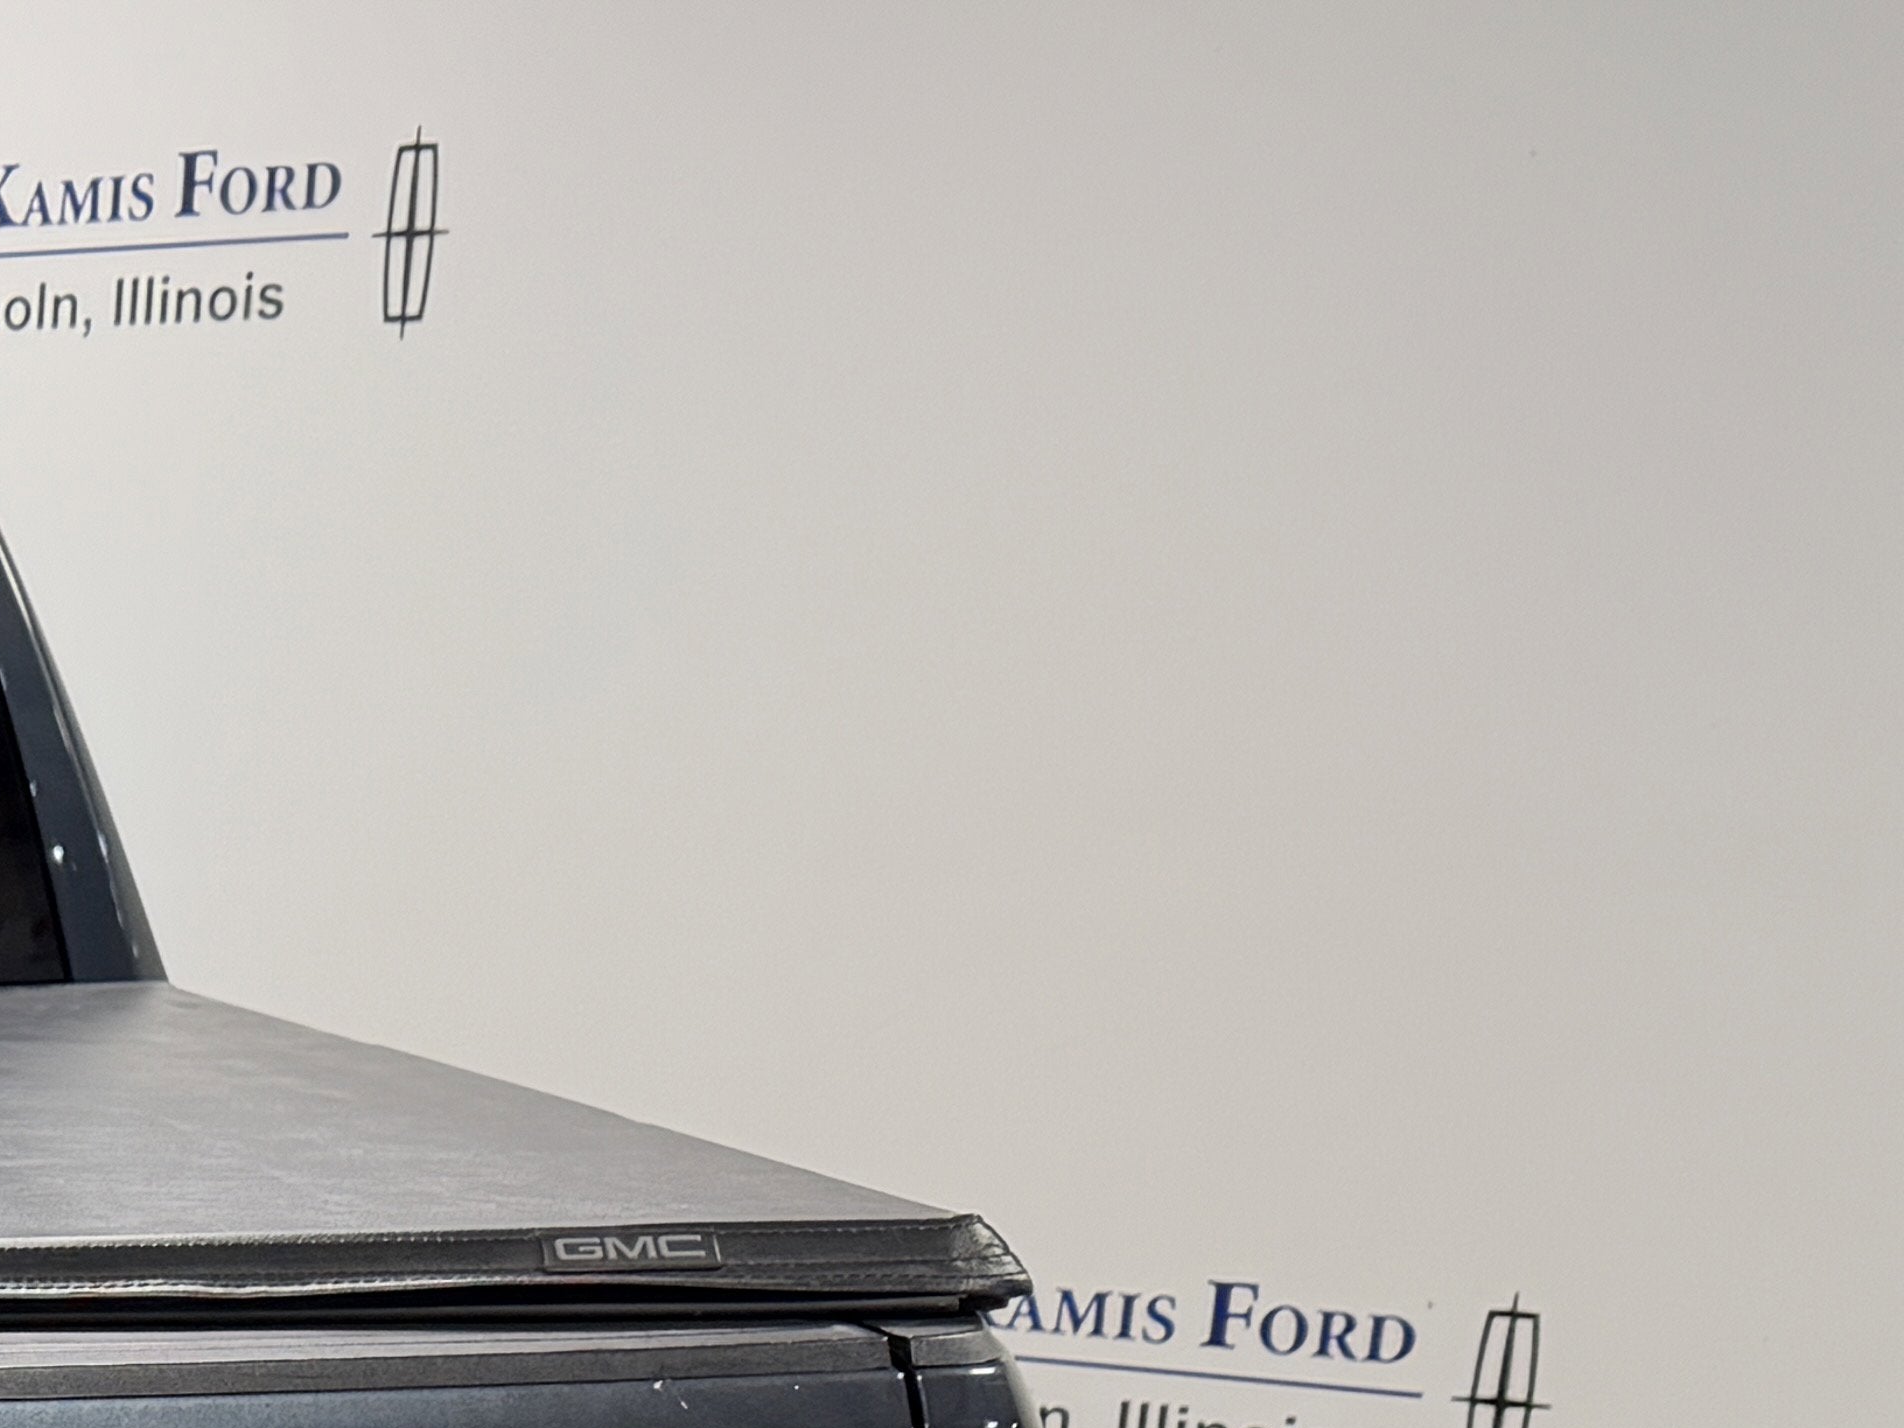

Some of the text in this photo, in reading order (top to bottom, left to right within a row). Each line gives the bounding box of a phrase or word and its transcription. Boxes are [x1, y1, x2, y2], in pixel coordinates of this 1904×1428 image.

[112, 270, 286, 329] Illinois
[554, 1233, 707, 1261] GMC
[986, 1286, 1177, 1345] AMIS
